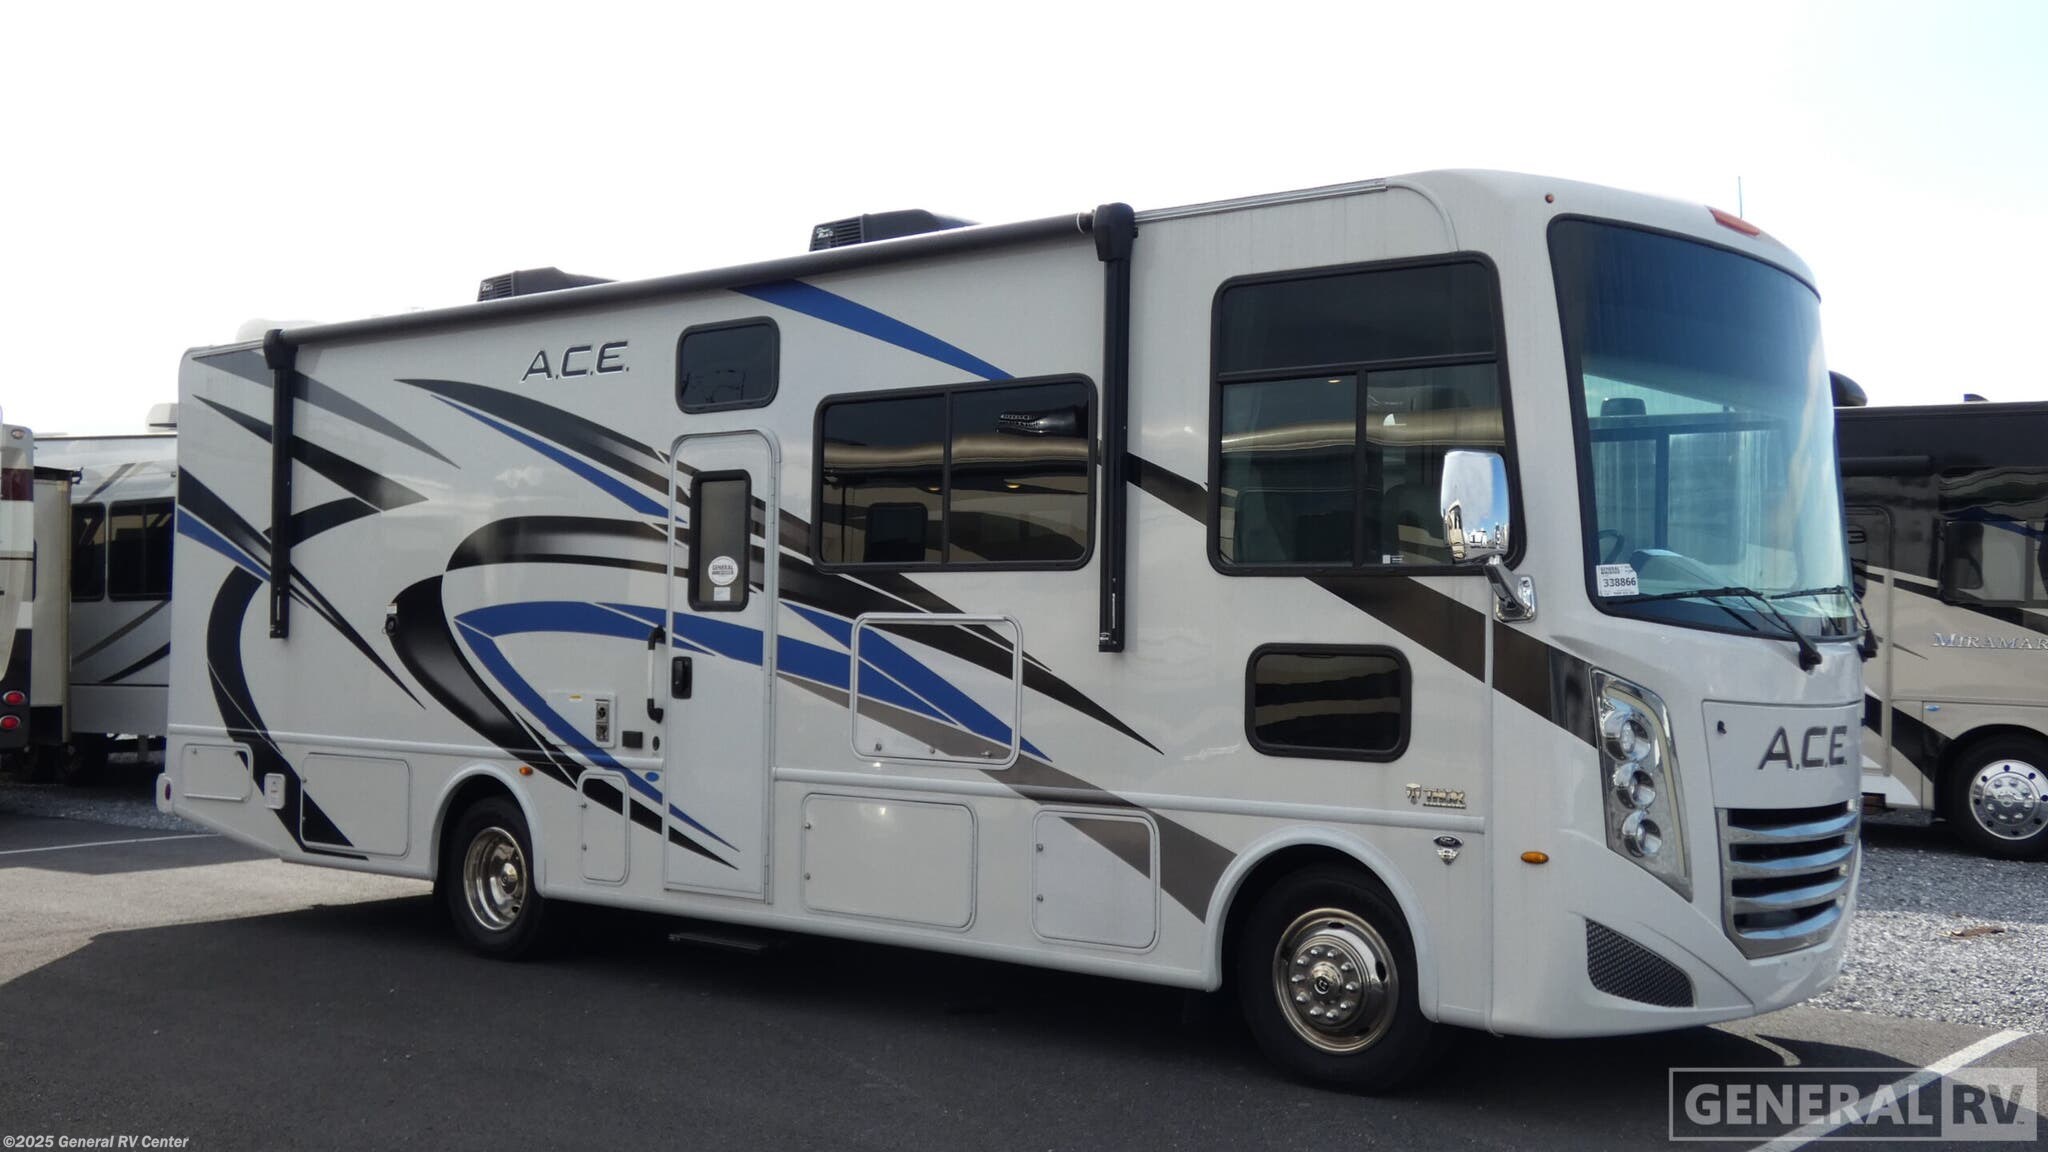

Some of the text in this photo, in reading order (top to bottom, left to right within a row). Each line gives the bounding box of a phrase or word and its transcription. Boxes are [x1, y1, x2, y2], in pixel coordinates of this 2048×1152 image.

[520, 341, 629, 383] A.C.E.
[1603, 577, 1637, 587] 338866
[1932, 632, 2048, 650] MIRAMAR
